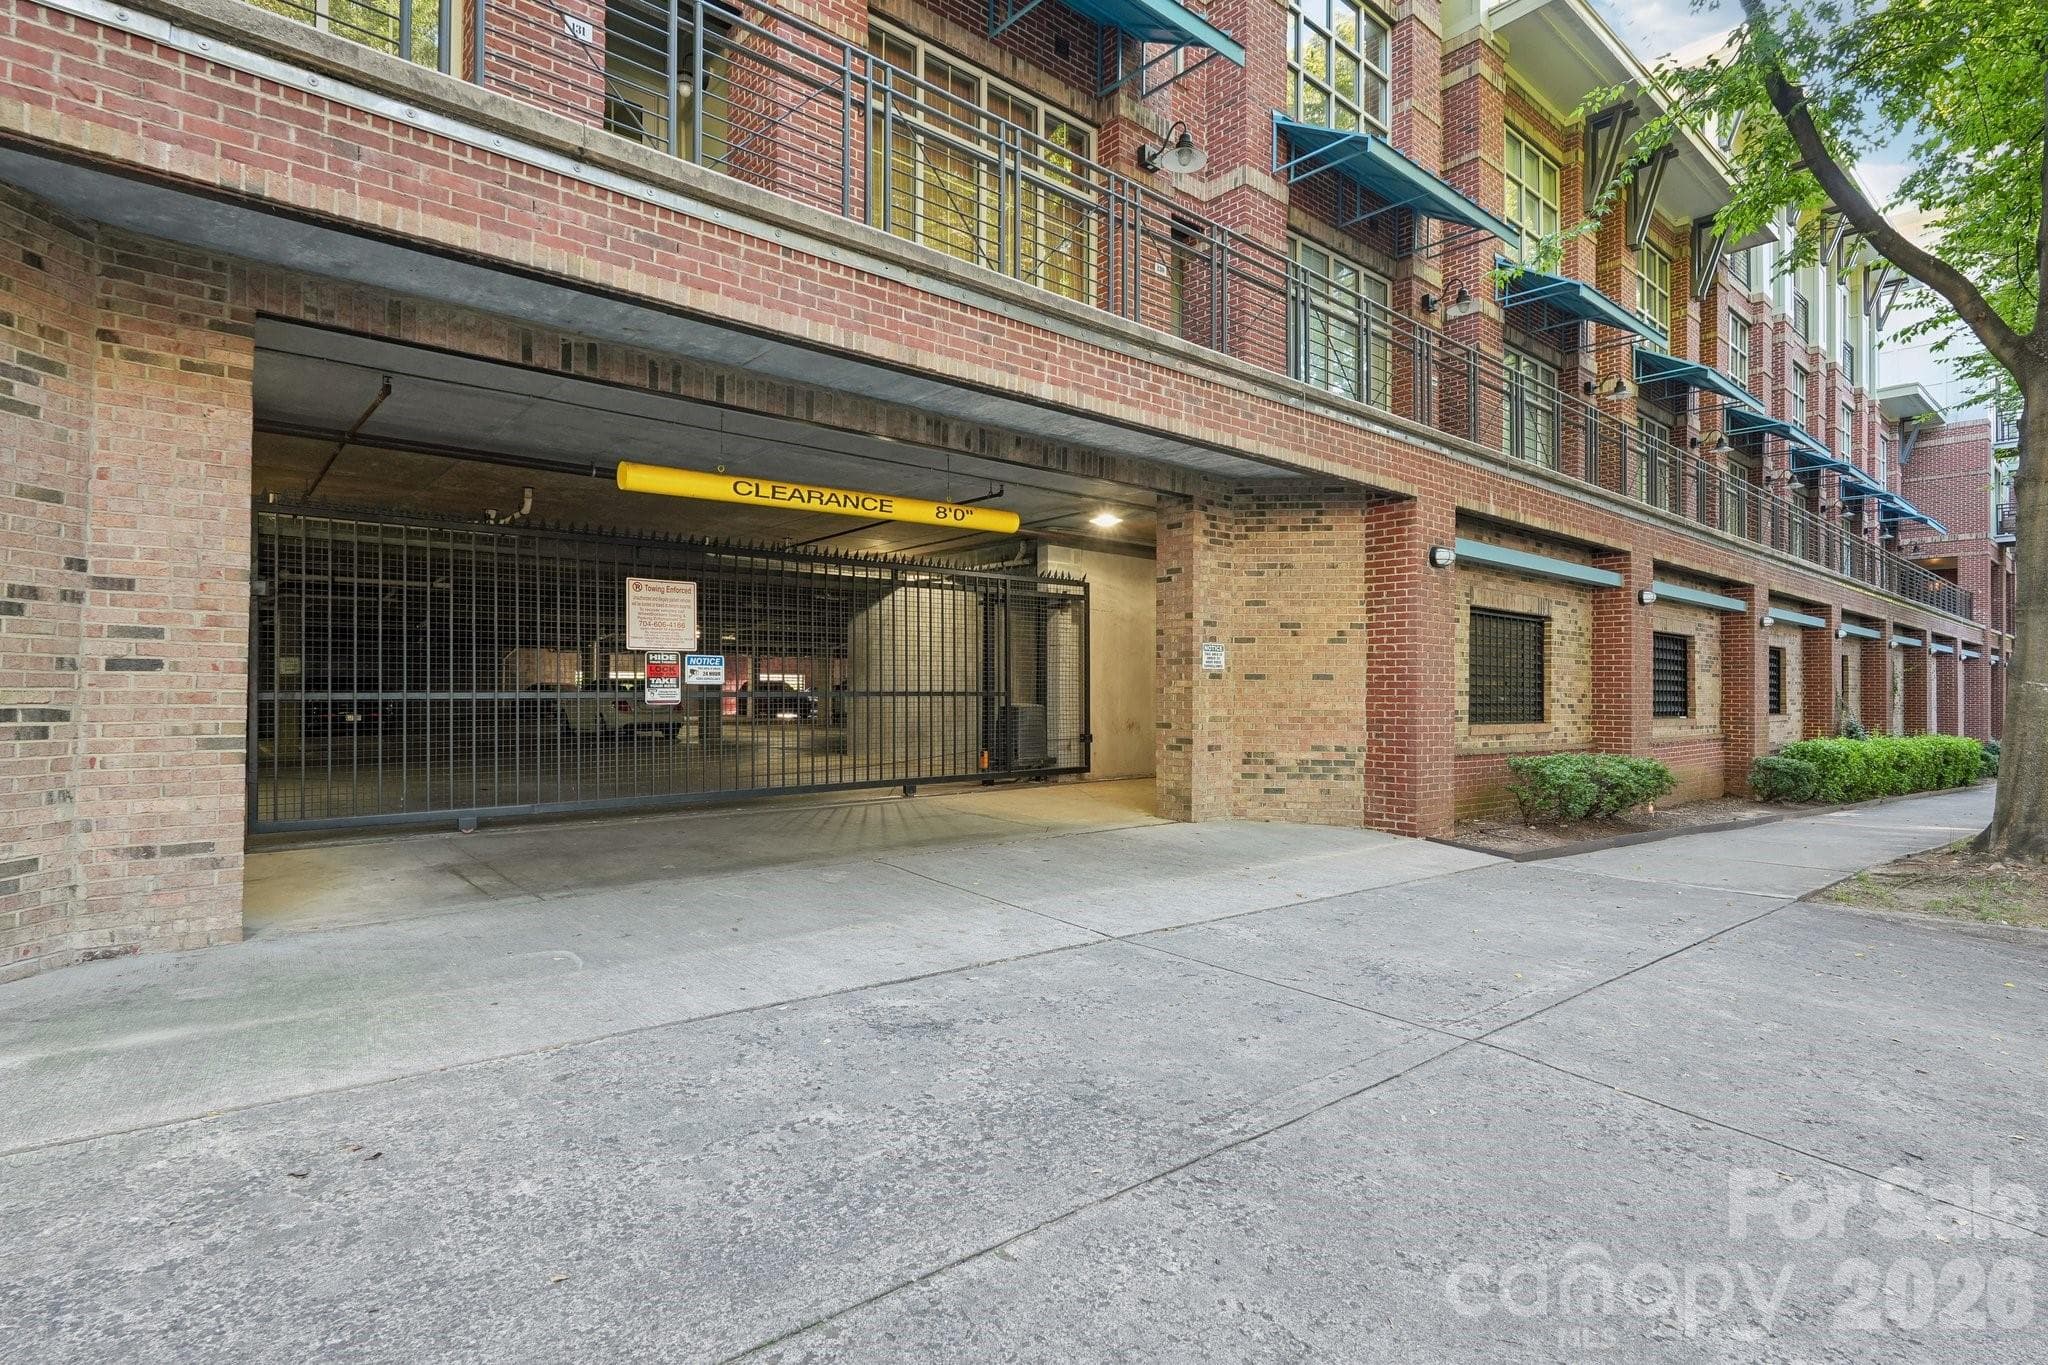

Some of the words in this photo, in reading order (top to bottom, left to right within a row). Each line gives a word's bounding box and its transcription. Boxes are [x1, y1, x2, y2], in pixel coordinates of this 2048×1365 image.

[571, 22, 586, 37] 131
[732, 479, 894, 514] CLEARANCE
[644, 584, 665, 595] Towing
[665, 585, 692, 595] Enforced
[689, 657, 721, 665] NOTICE
